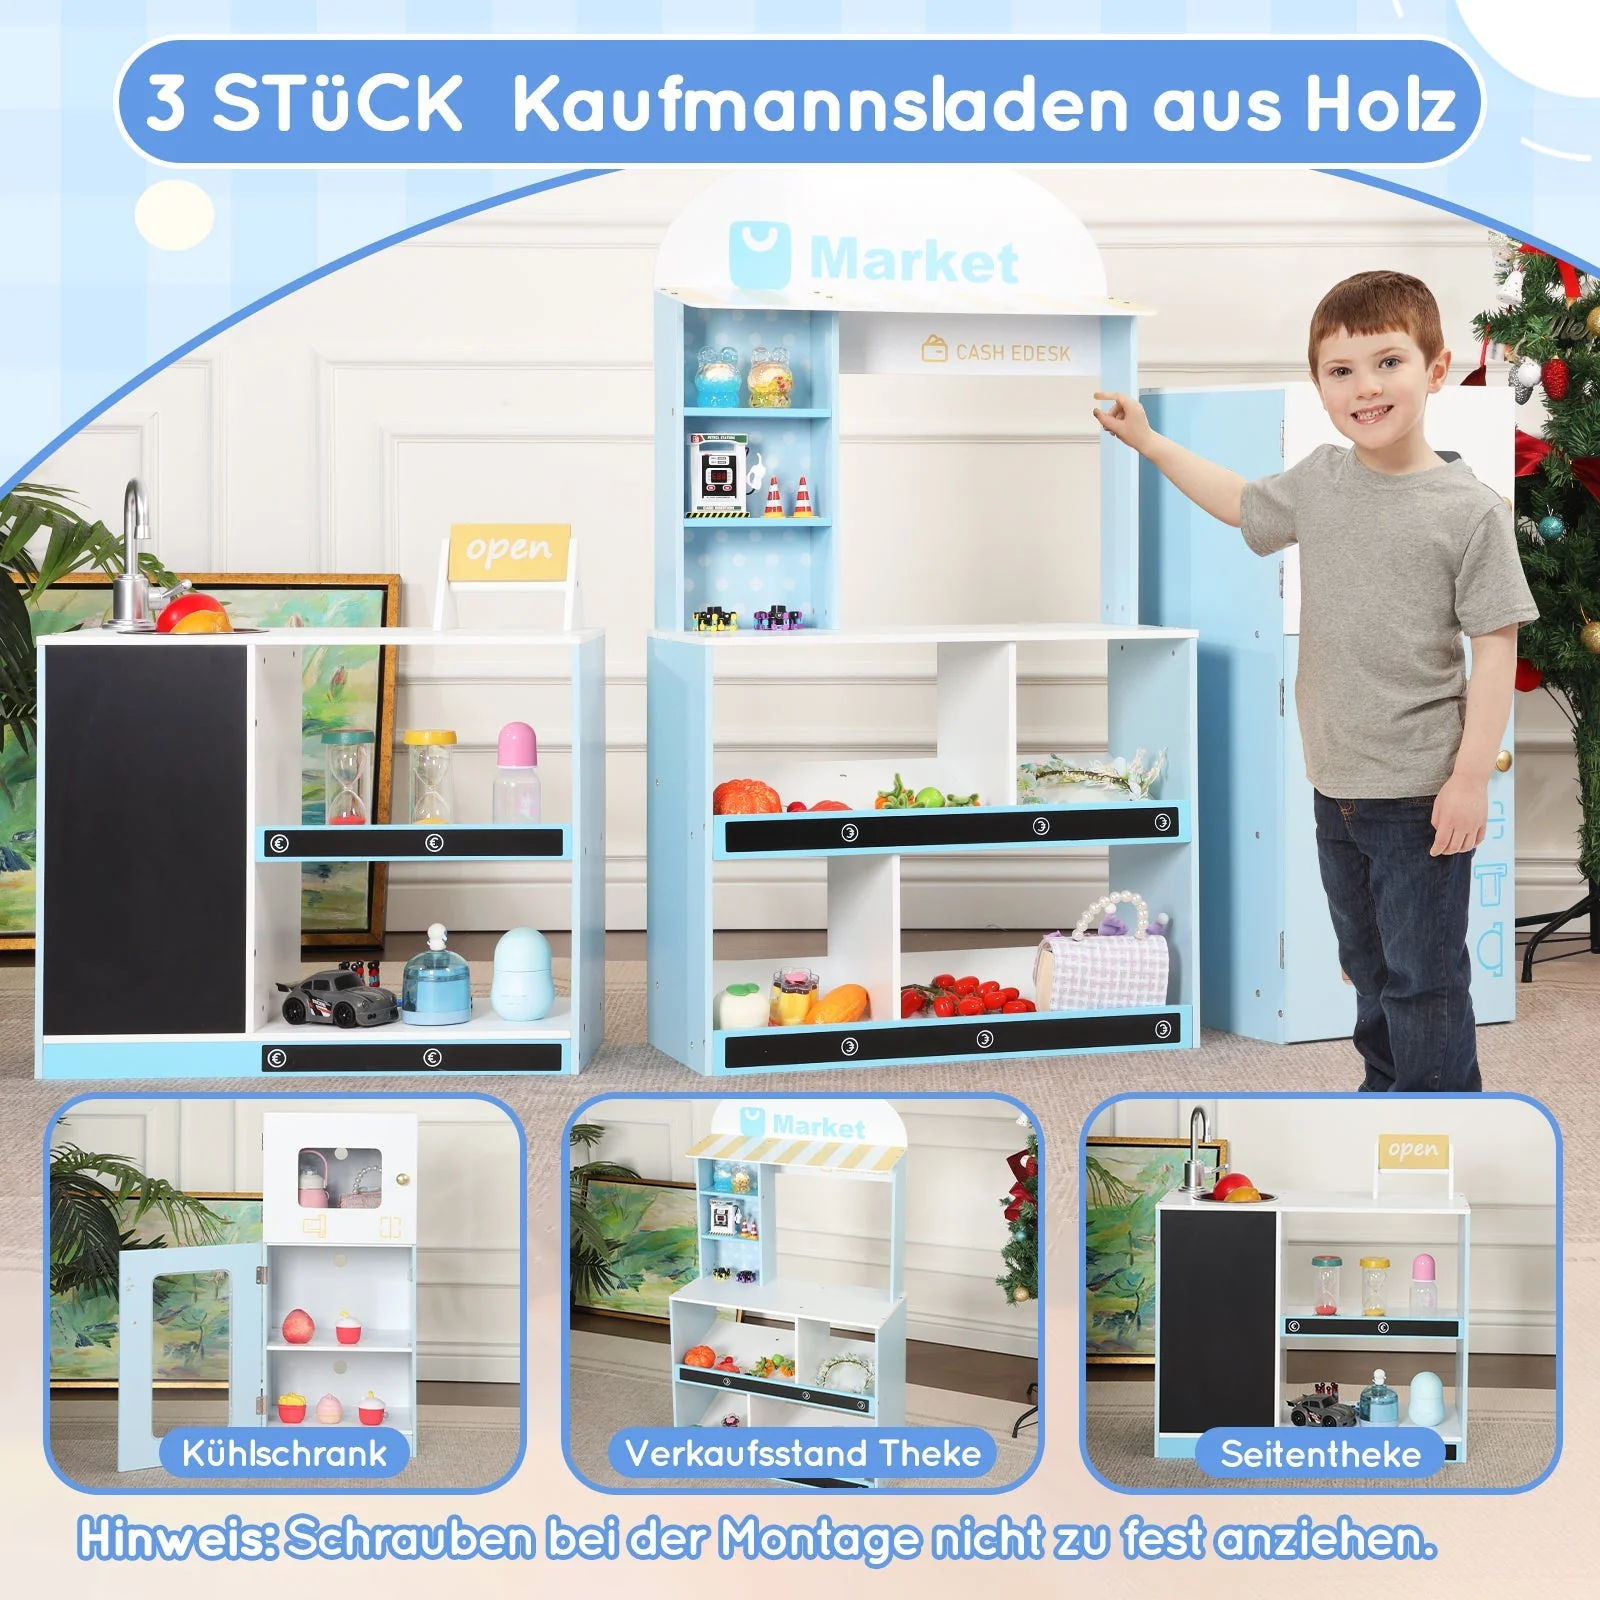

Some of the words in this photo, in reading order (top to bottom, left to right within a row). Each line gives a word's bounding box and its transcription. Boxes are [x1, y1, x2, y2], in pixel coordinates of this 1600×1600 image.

[811, 235, 1019, 284] Market
[957, 343, 1005, 361] CASH
[1011, 344, 1071, 362] EDESK
[466, 538, 553, 570] open
[773, 1113, 865, 1141] Market
[1388, 1142, 1439, 1162] open
